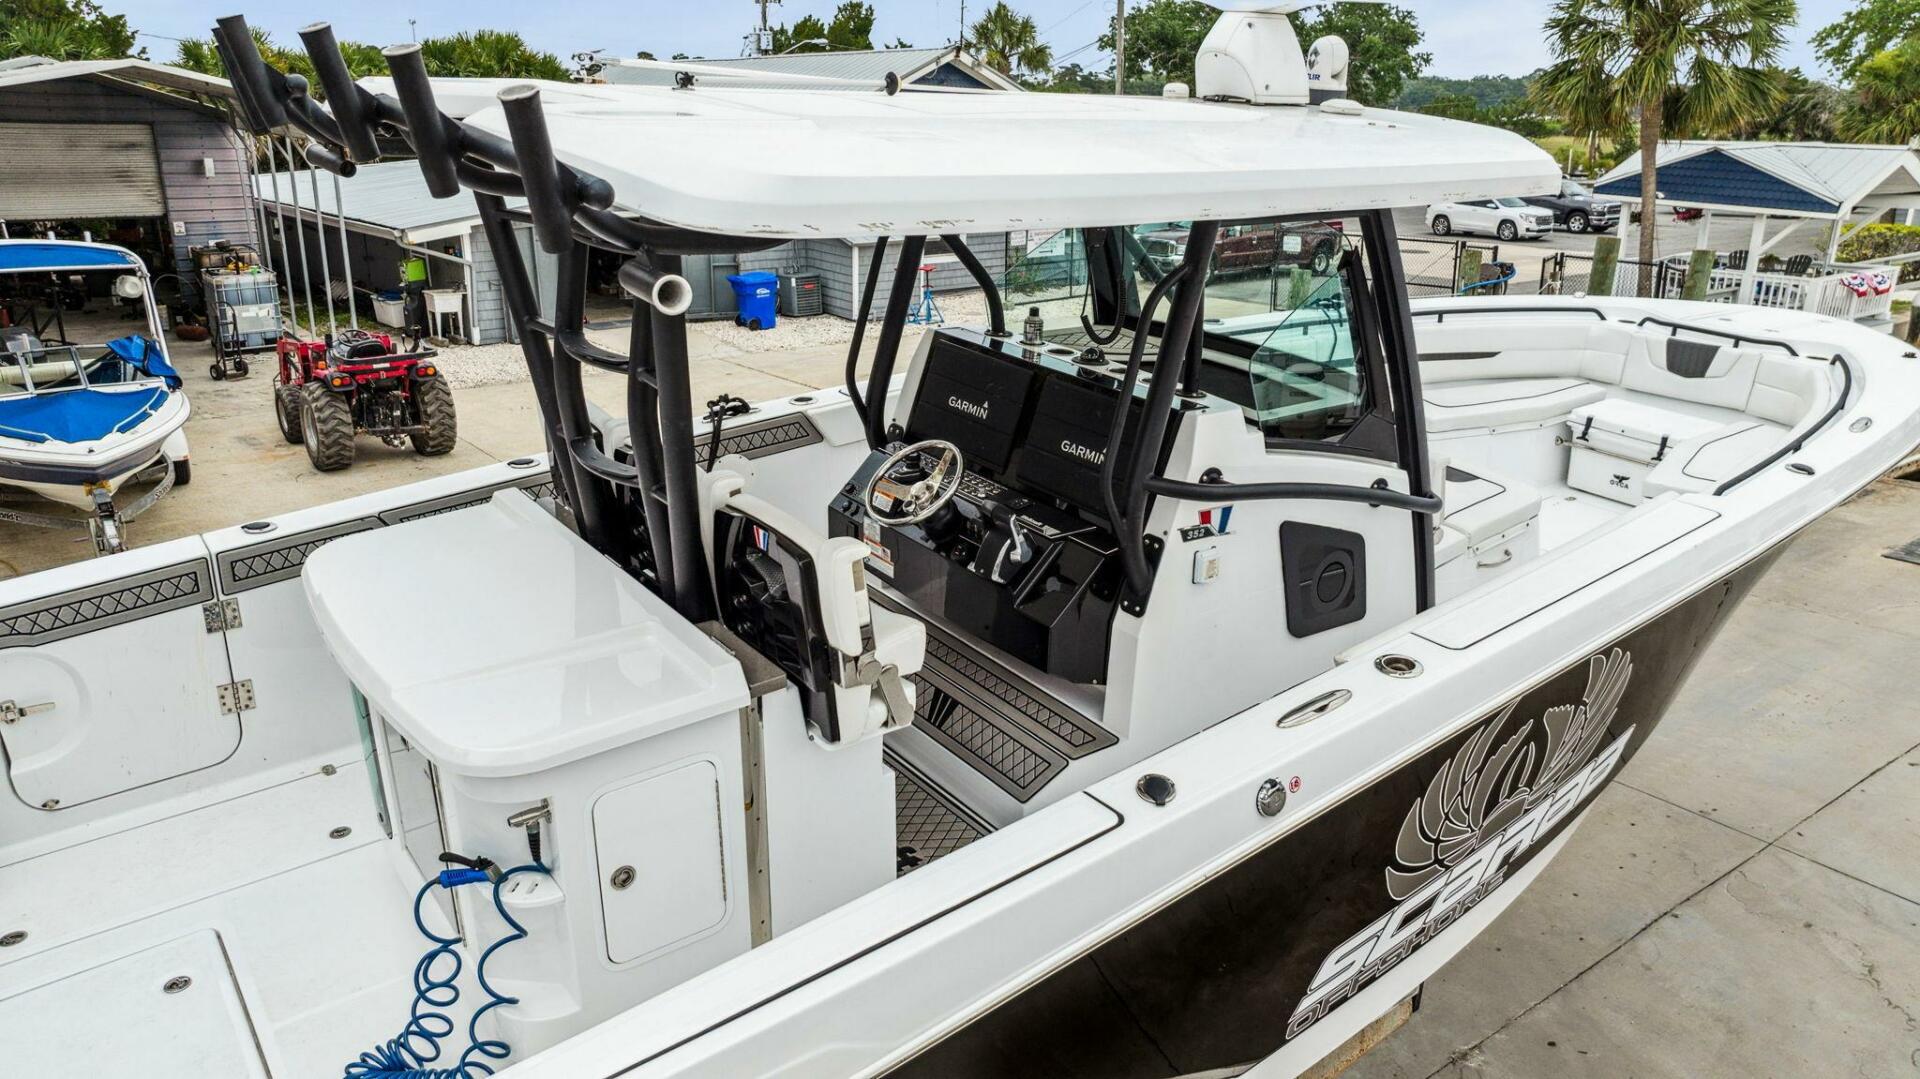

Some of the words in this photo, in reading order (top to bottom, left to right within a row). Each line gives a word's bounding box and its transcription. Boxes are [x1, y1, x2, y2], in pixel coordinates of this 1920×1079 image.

[1307, 73, 1321, 81] LIR
[948, 396, 988, 420] GARMIN
[1610, 479, 1629, 489] ORCA
[1187, 529, 1205, 540] 352
[1285, 866, 1509, 1040] OFFSHORE
